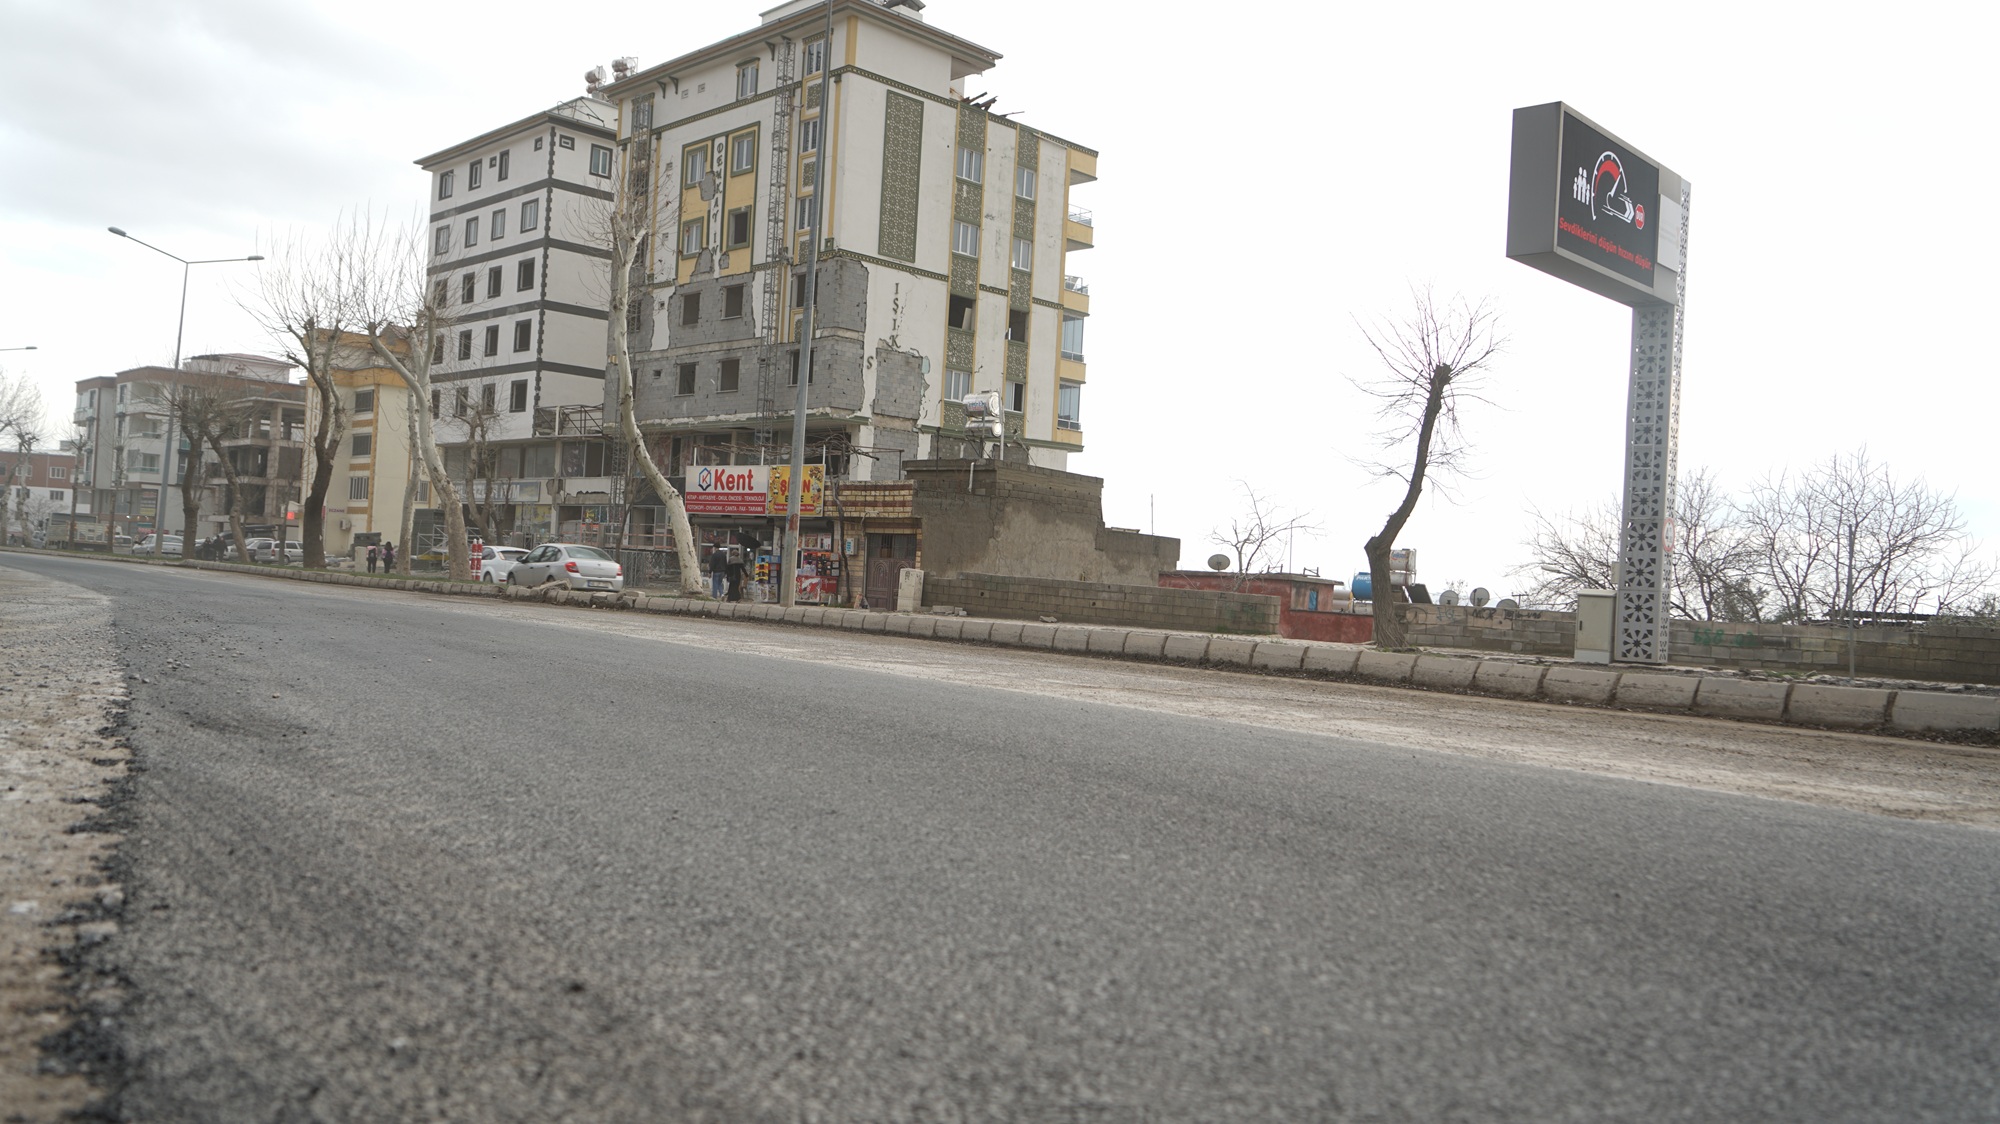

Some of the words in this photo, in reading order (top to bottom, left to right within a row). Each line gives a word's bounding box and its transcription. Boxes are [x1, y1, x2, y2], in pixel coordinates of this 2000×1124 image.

[1559, 217, 1598, 245] Sevdiklerini
[1598, 236, 1617, 254] düşün
[713, 468, 754, 491] Kent
